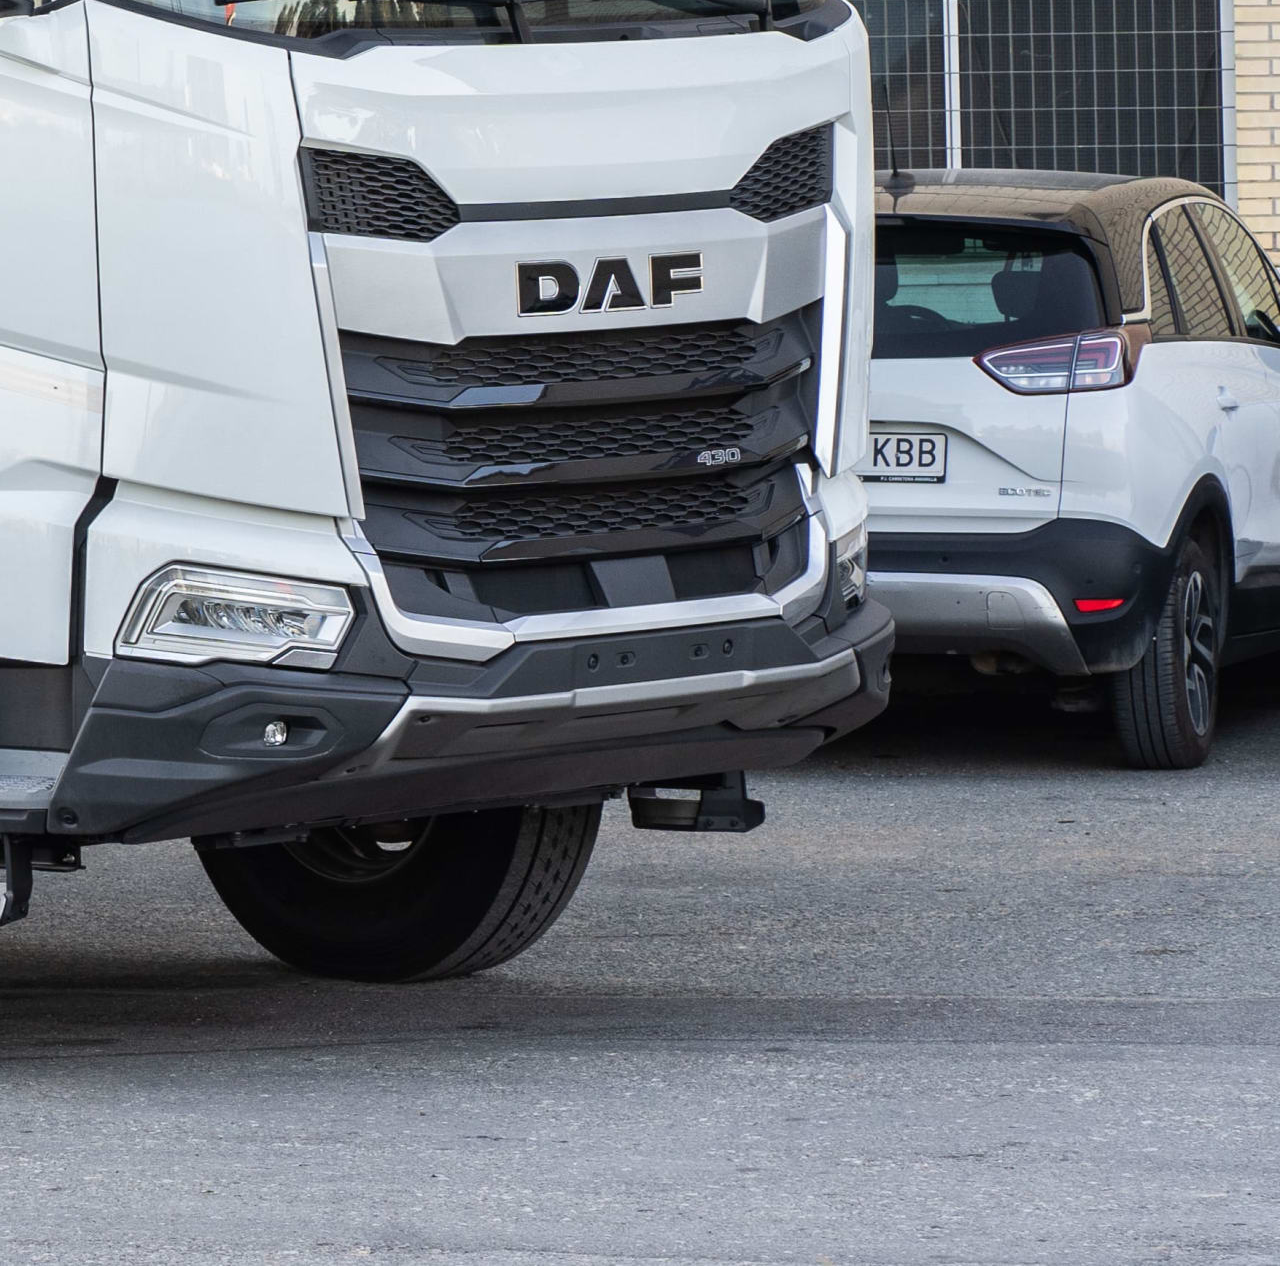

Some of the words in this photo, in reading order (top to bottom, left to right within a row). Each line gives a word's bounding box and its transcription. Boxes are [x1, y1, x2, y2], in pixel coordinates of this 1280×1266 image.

[515, 250, 704, 317] DAF
[697, 447, 741, 465] 430
[873, 438, 936, 467] KBB
[999, 487, 1052, 497] ECOTEC
